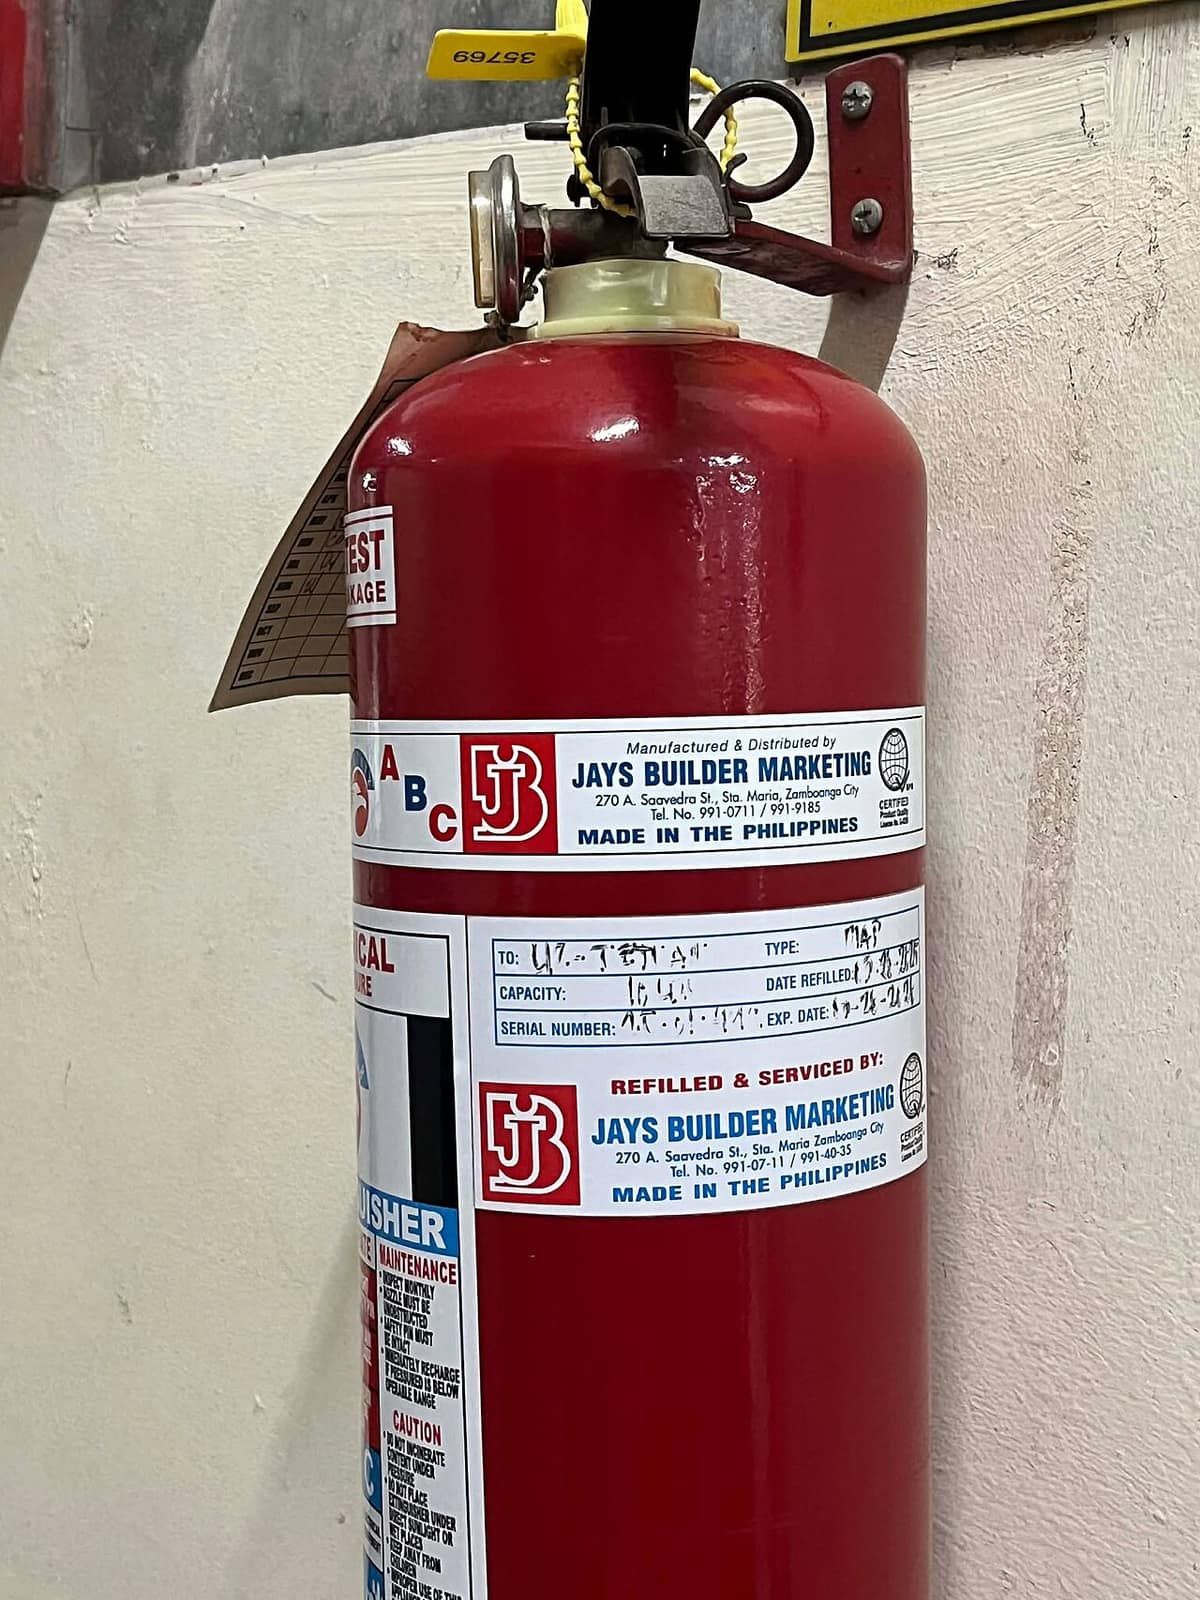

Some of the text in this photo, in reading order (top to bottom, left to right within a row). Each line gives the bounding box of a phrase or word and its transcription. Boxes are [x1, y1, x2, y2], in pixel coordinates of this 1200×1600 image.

[452, 50, 536, 64] 35769
[346, 530, 384, 574] EST
[627, 736, 836, 754] Manufactured & Distributed by
[572, 751, 872, 788] JAYS BUILDER MARKETING
[380, 744, 458, 842] A B C
[595, 784, 859, 806] 270 A. Saavedra St., Sta. Maria, Zamboanga City
[650, 801, 820, 821] Tel. No. 991-0711 / 991-9185
[578, 817, 858, 844] MADE IN THE PHILIPPINES
[498, 951, 520, 966] TO:
[764, 940, 800, 956] TYPE:
[500, 986, 566, 1001] CAPACITY:
[766, 968, 854, 992] DATE REFILLED:
[501, 1022, 616, 1036] SERIAL NUMBER:
[767, 1006, 830, 1026] EXP. DATE:
[611, 1052, 884, 1095] REFILLED & SERVICED BY:
[592, 1084, 894, 1145] JAYS BUILDER MARKETING
[616, 1121, 884, 1164] 270 A. Saavedra St., Sta. Maria Zamboanga City
[670, 1144, 852, 1178] Tel. No. 991-07-11 / 991-40-35
[612, 1153, 887, 1202] MADE IN THE PHILIPPINES
[380, 1244, 456, 1285] MAINTENANCE
[393, 1410, 442, 1446] CAUTION
